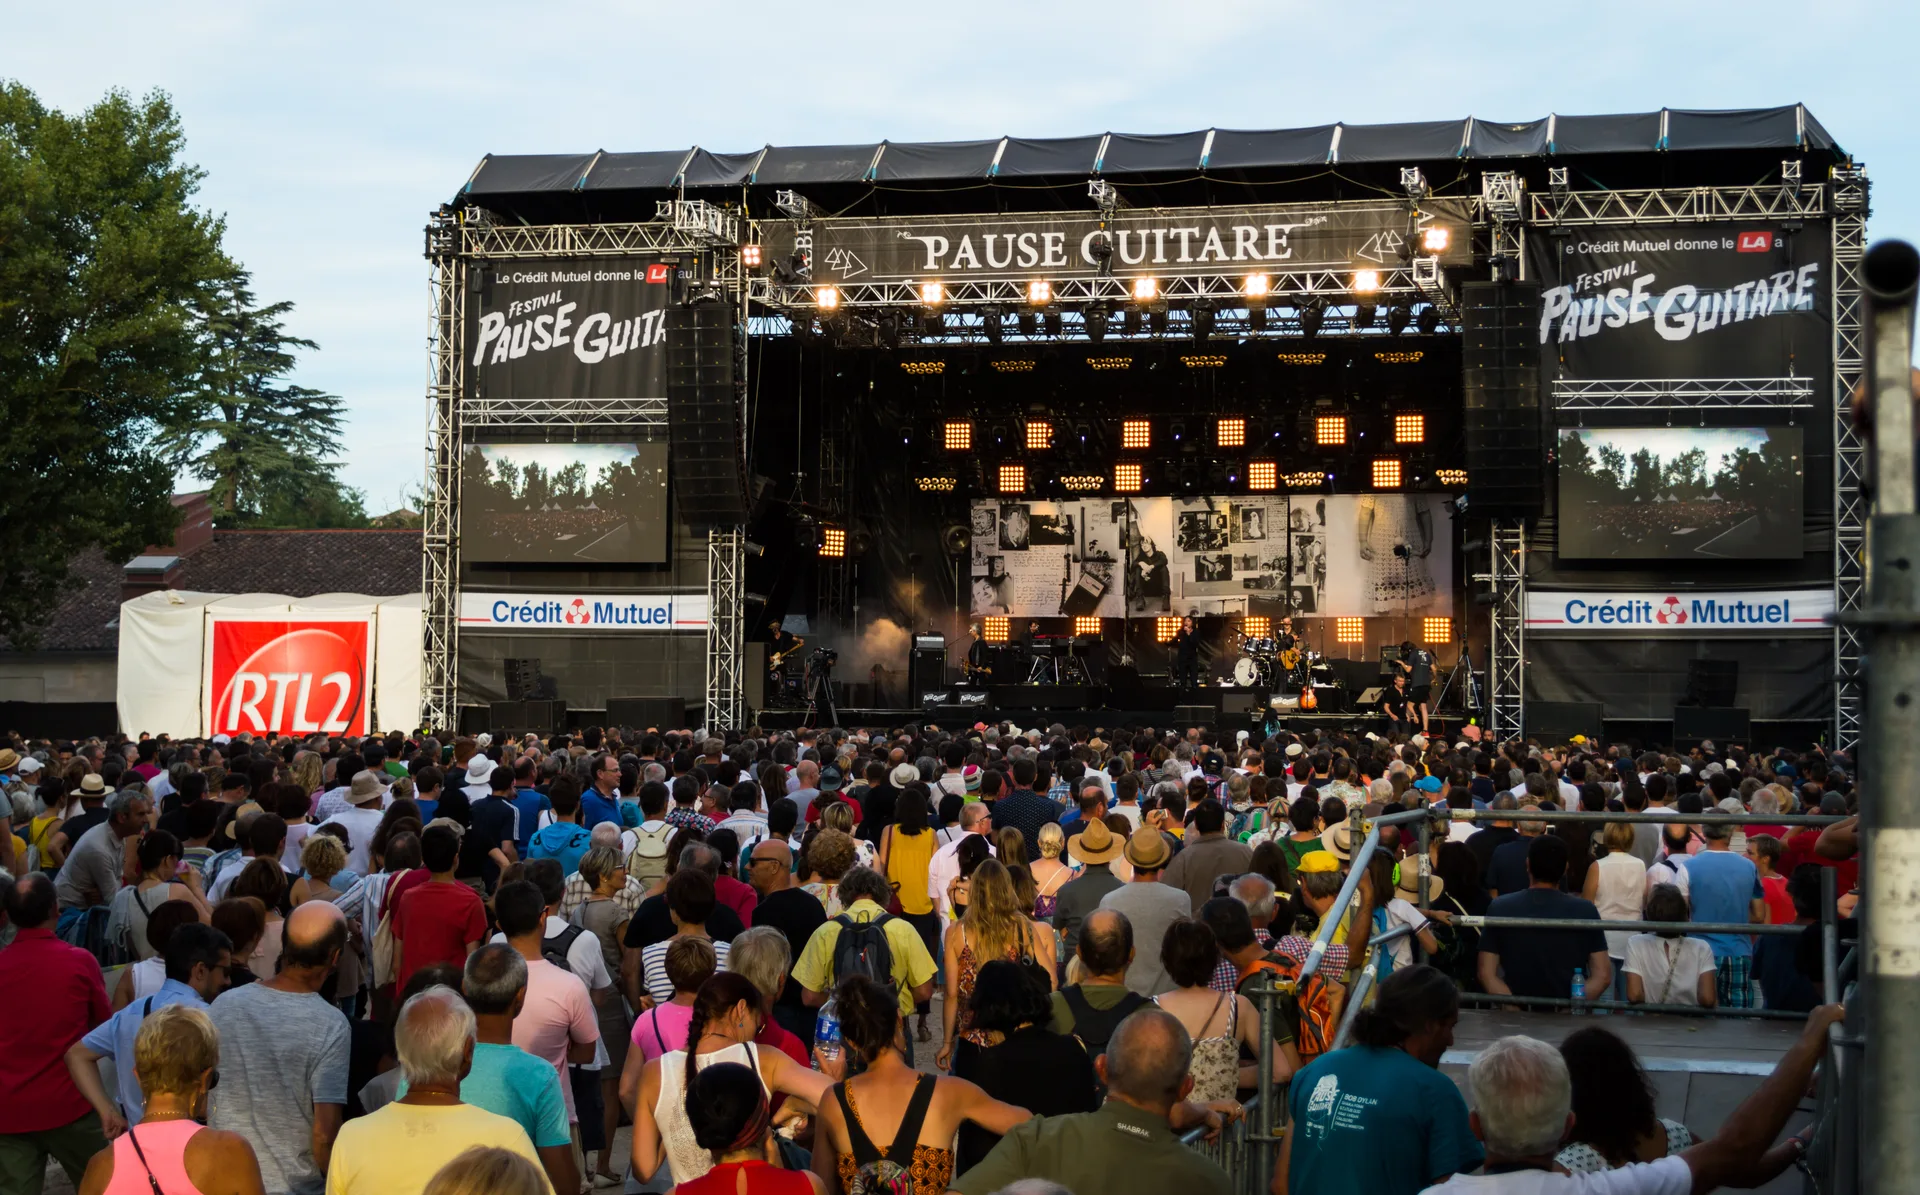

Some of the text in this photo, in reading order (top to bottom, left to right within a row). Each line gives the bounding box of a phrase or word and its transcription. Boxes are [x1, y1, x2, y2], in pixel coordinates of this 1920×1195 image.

[908, 222, 1294, 270] PAUSE GUITARE
[1577, 241, 1620, 254] Crédit
[1623, 239, 1670, 253] Mutuel
[1674, 238, 1718, 250] donne
[1721, 237, 1734, 249] le
[1742, 236, 1766, 249] LA
[495, 272, 511, 284] Le
[512, 271, 549, 284] Crédit
[551, 270, 591, 283] Mutuel
[593, 269, 632, 281] donne
[633, 268, 645, 280] le
[677, 269, 693, 279] au
[1575, 260, 1638, 293] FESTIVAL
[508, 290, 563, 319] FESTIVAL
[1539, 262, 1818, 344] PAUSE GUITARE
[472, 301, 577, 367] PAUSE
[492, 600, 673, 625] Crédit Mutuel
[1565, 599, 1790, 624] Crédit Mutuel
[226, 671, 352, 733] RTL2
[1344, 1093, 1377, 1105] BOB DYLAN
[1117, 1122, 1150, 1136] SHABRAK
